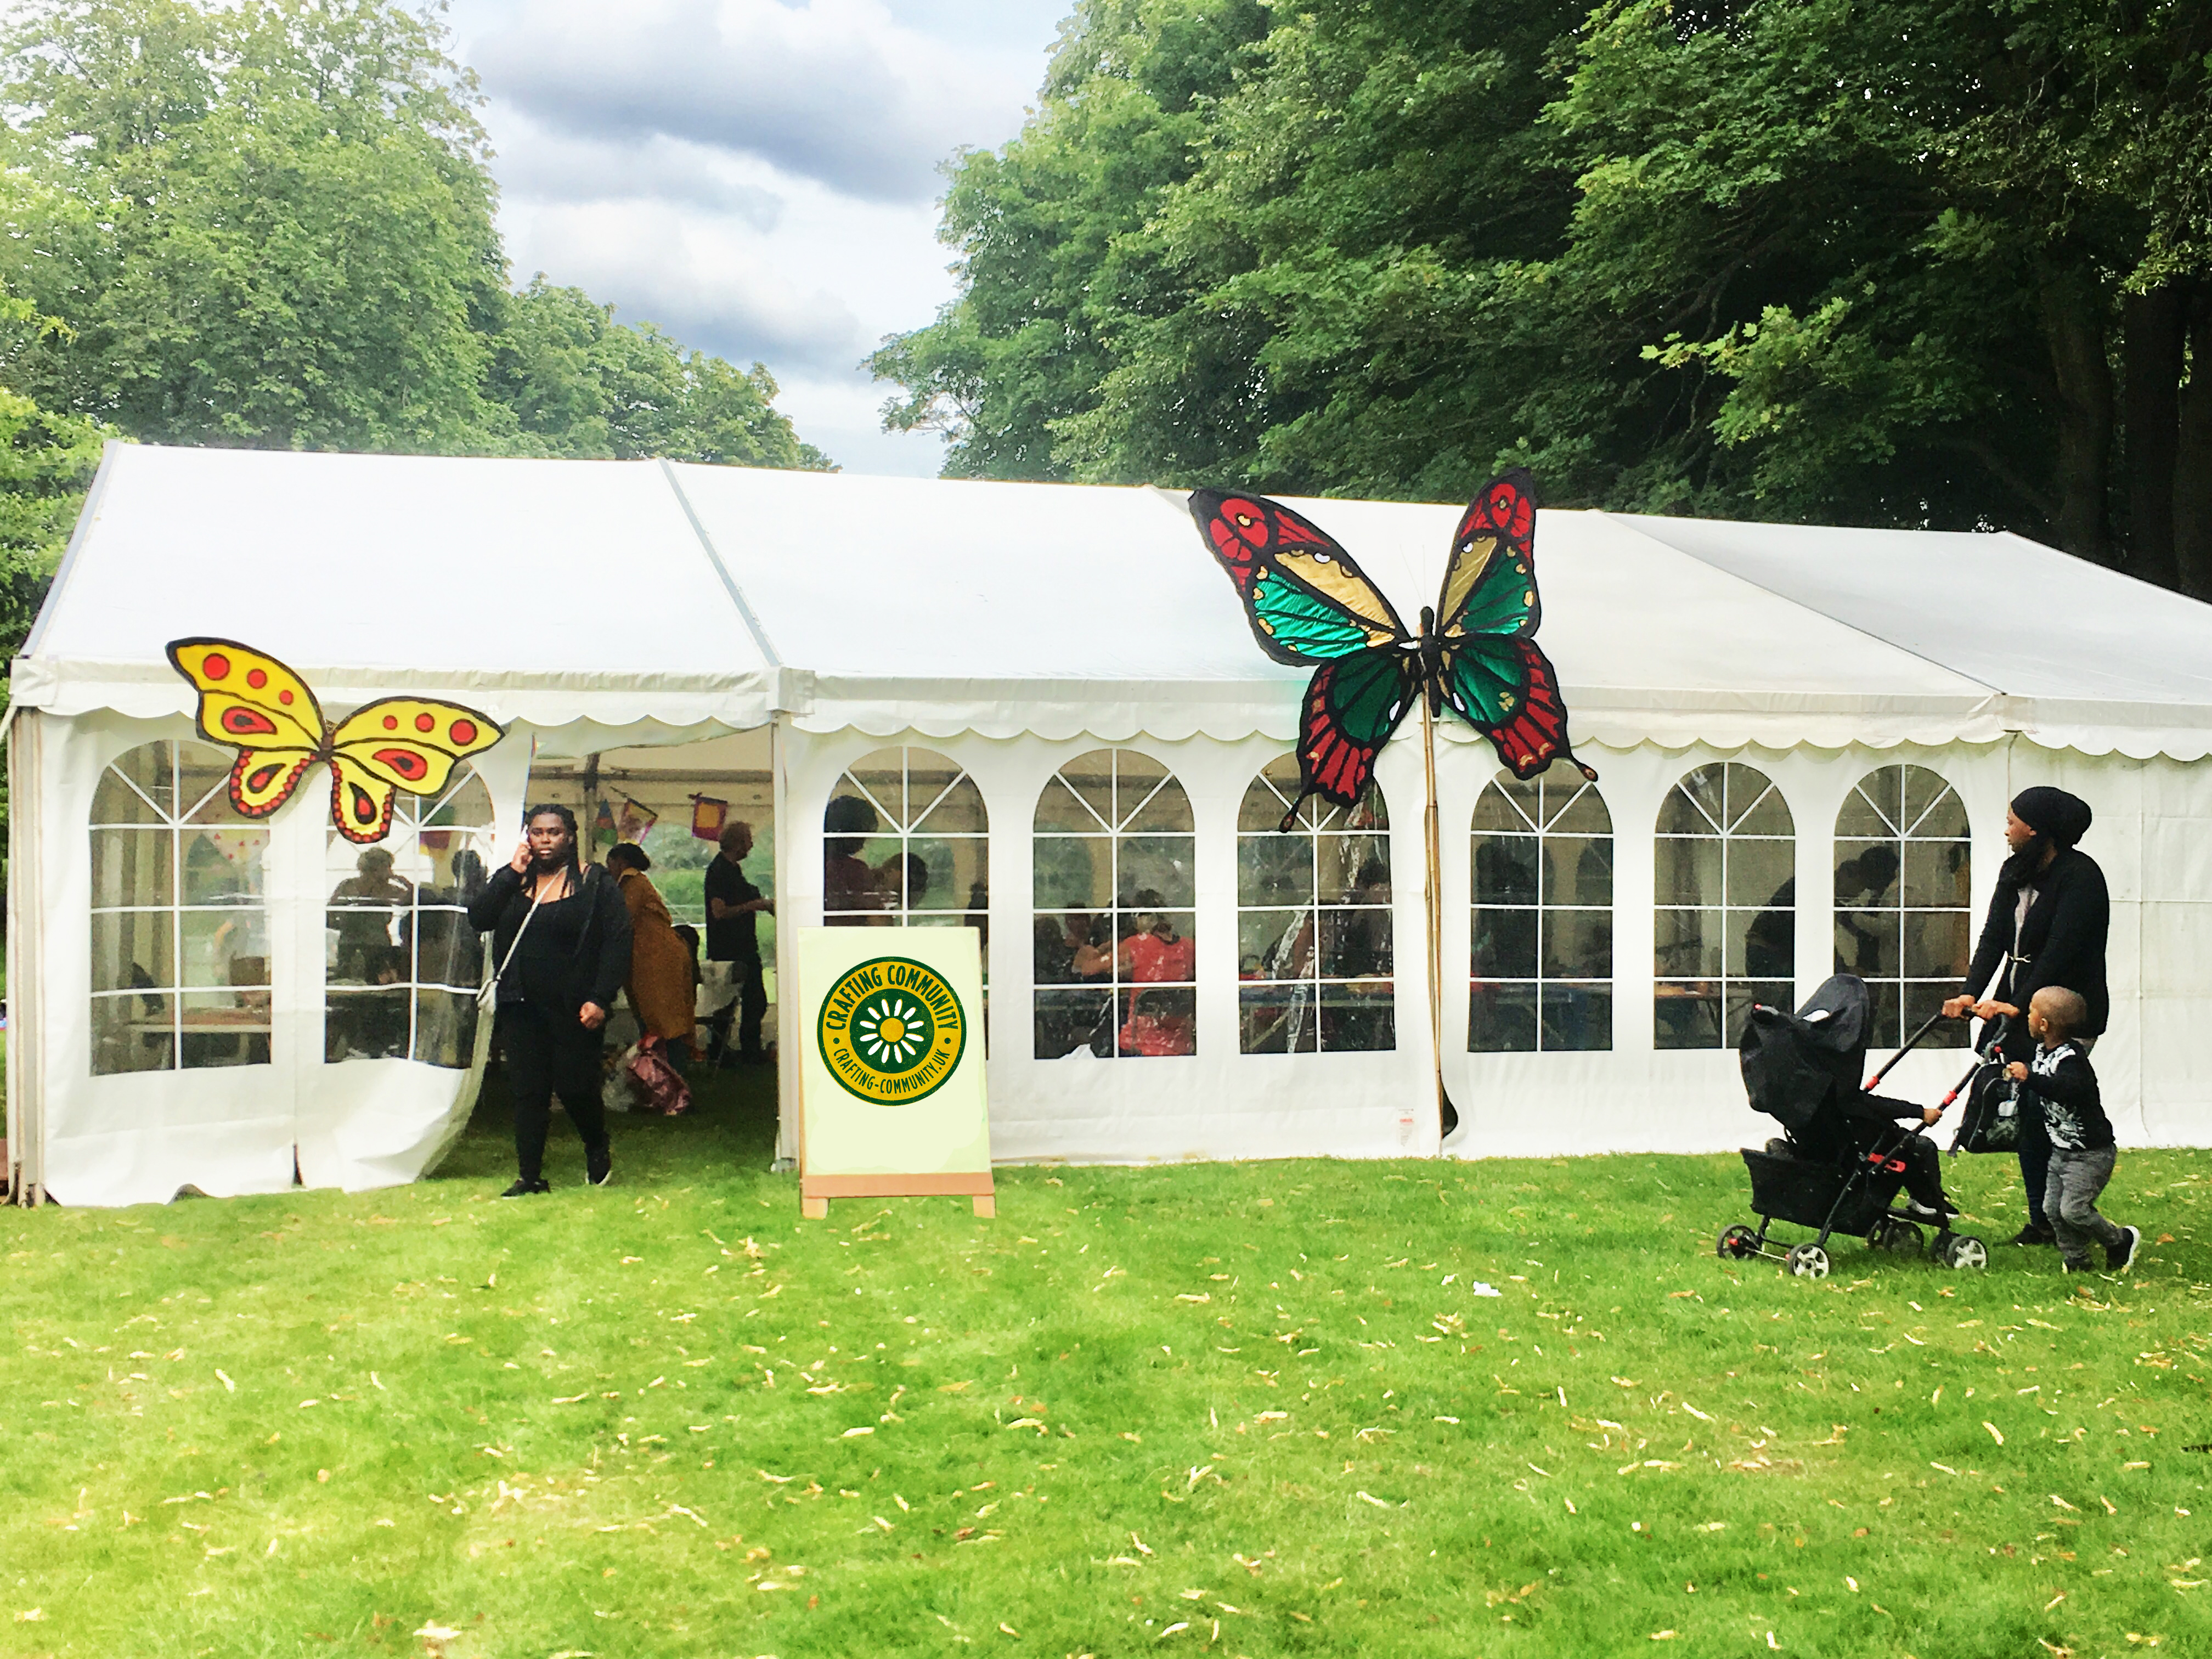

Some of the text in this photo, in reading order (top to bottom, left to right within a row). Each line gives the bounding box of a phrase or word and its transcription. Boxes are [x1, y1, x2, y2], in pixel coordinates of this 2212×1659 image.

[826, 964, 958, 1030] CRAFTING COMMUNITY
[833, 1048, 950, 1094] CRAFTING-COMMUNITY.UK
